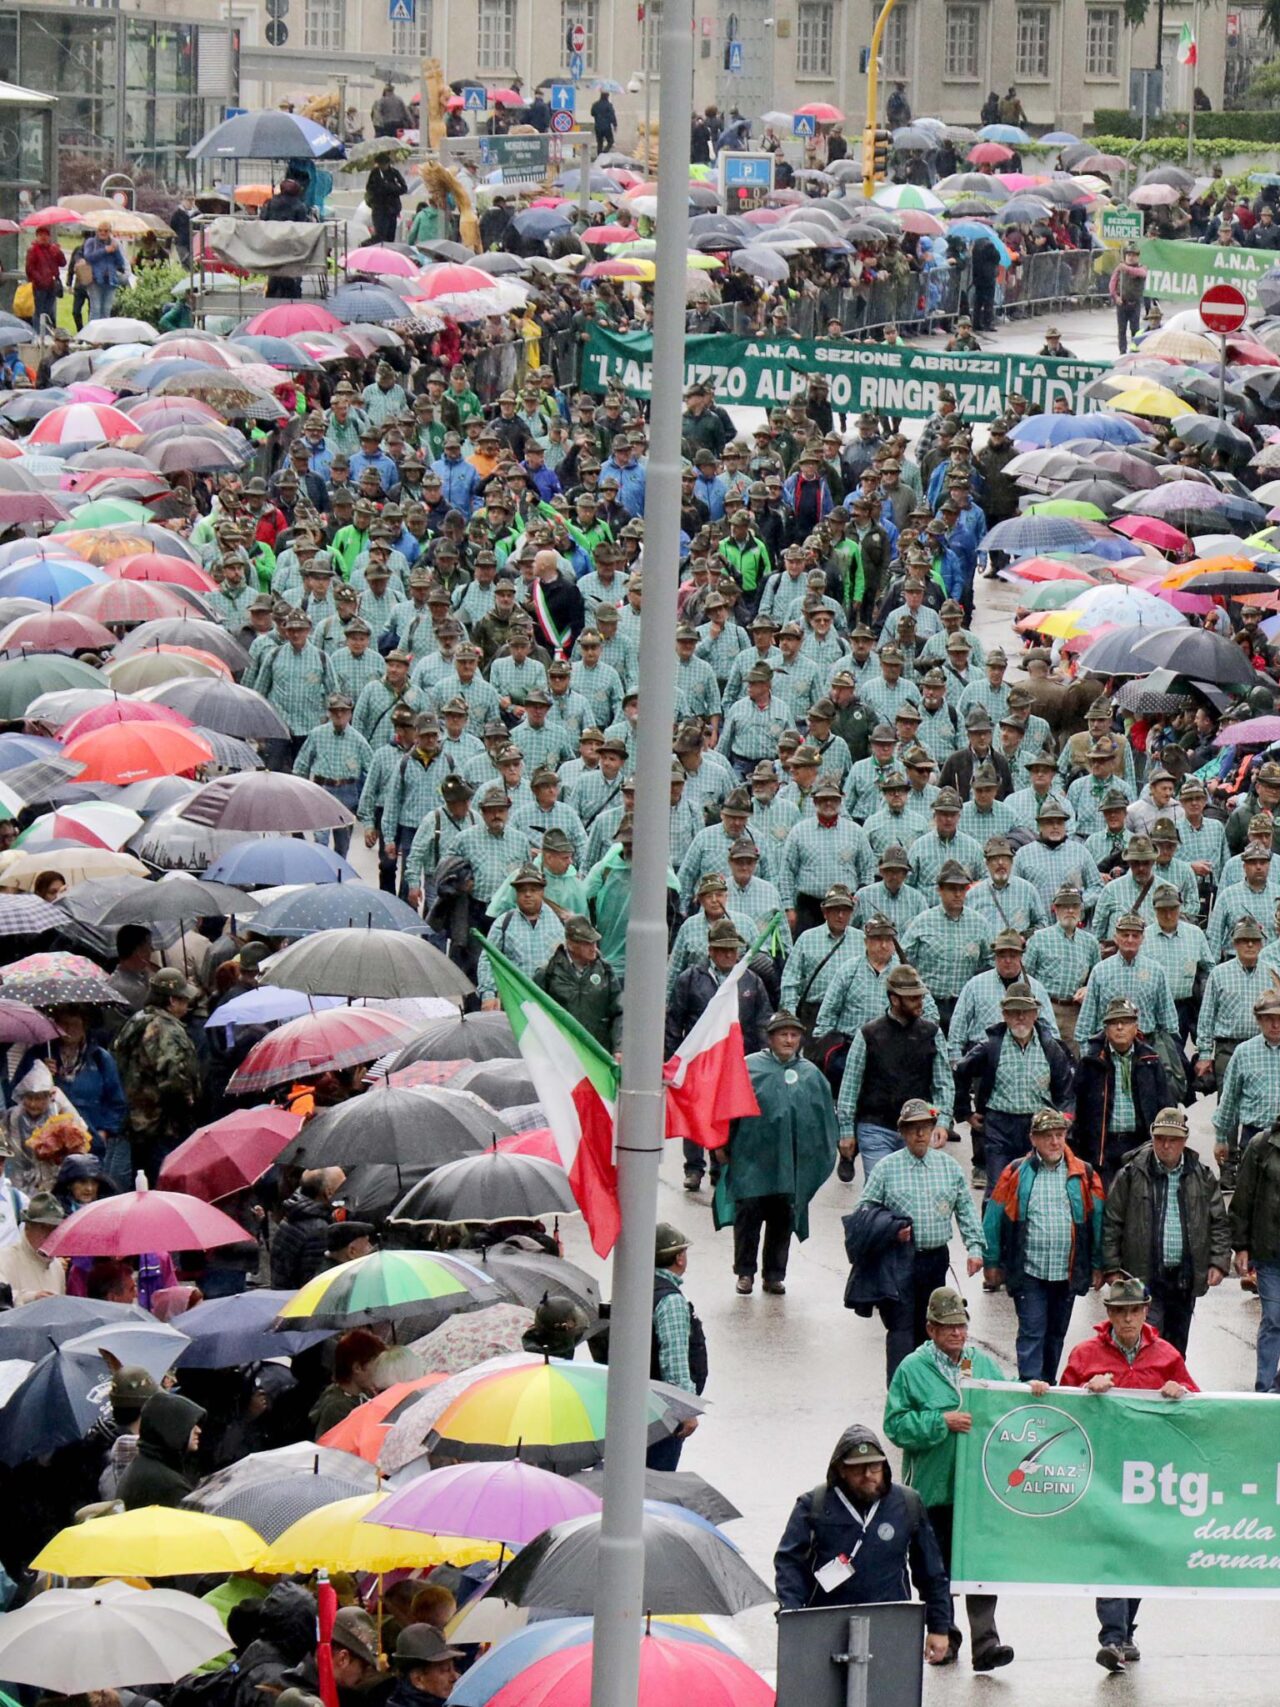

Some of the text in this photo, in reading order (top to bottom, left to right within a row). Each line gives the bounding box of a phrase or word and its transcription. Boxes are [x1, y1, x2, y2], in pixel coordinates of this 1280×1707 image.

[1108, 217, 1136, 225] SEZIONE
[1103, 225, 1140, 239] MARCHE
[1213, 252, 1260, 271] A.N.A.
[744, 343, 1000, 374] A.N.A. SEZIONE ABRUZZI
[1018, 362, 1108, 382] LA CITT
[1023, 1481, 1075, 1494] ALPINI
[1122, 1460, 1224, 1517] Btg.
[1193, 1517, 1276, 1541] dalla
